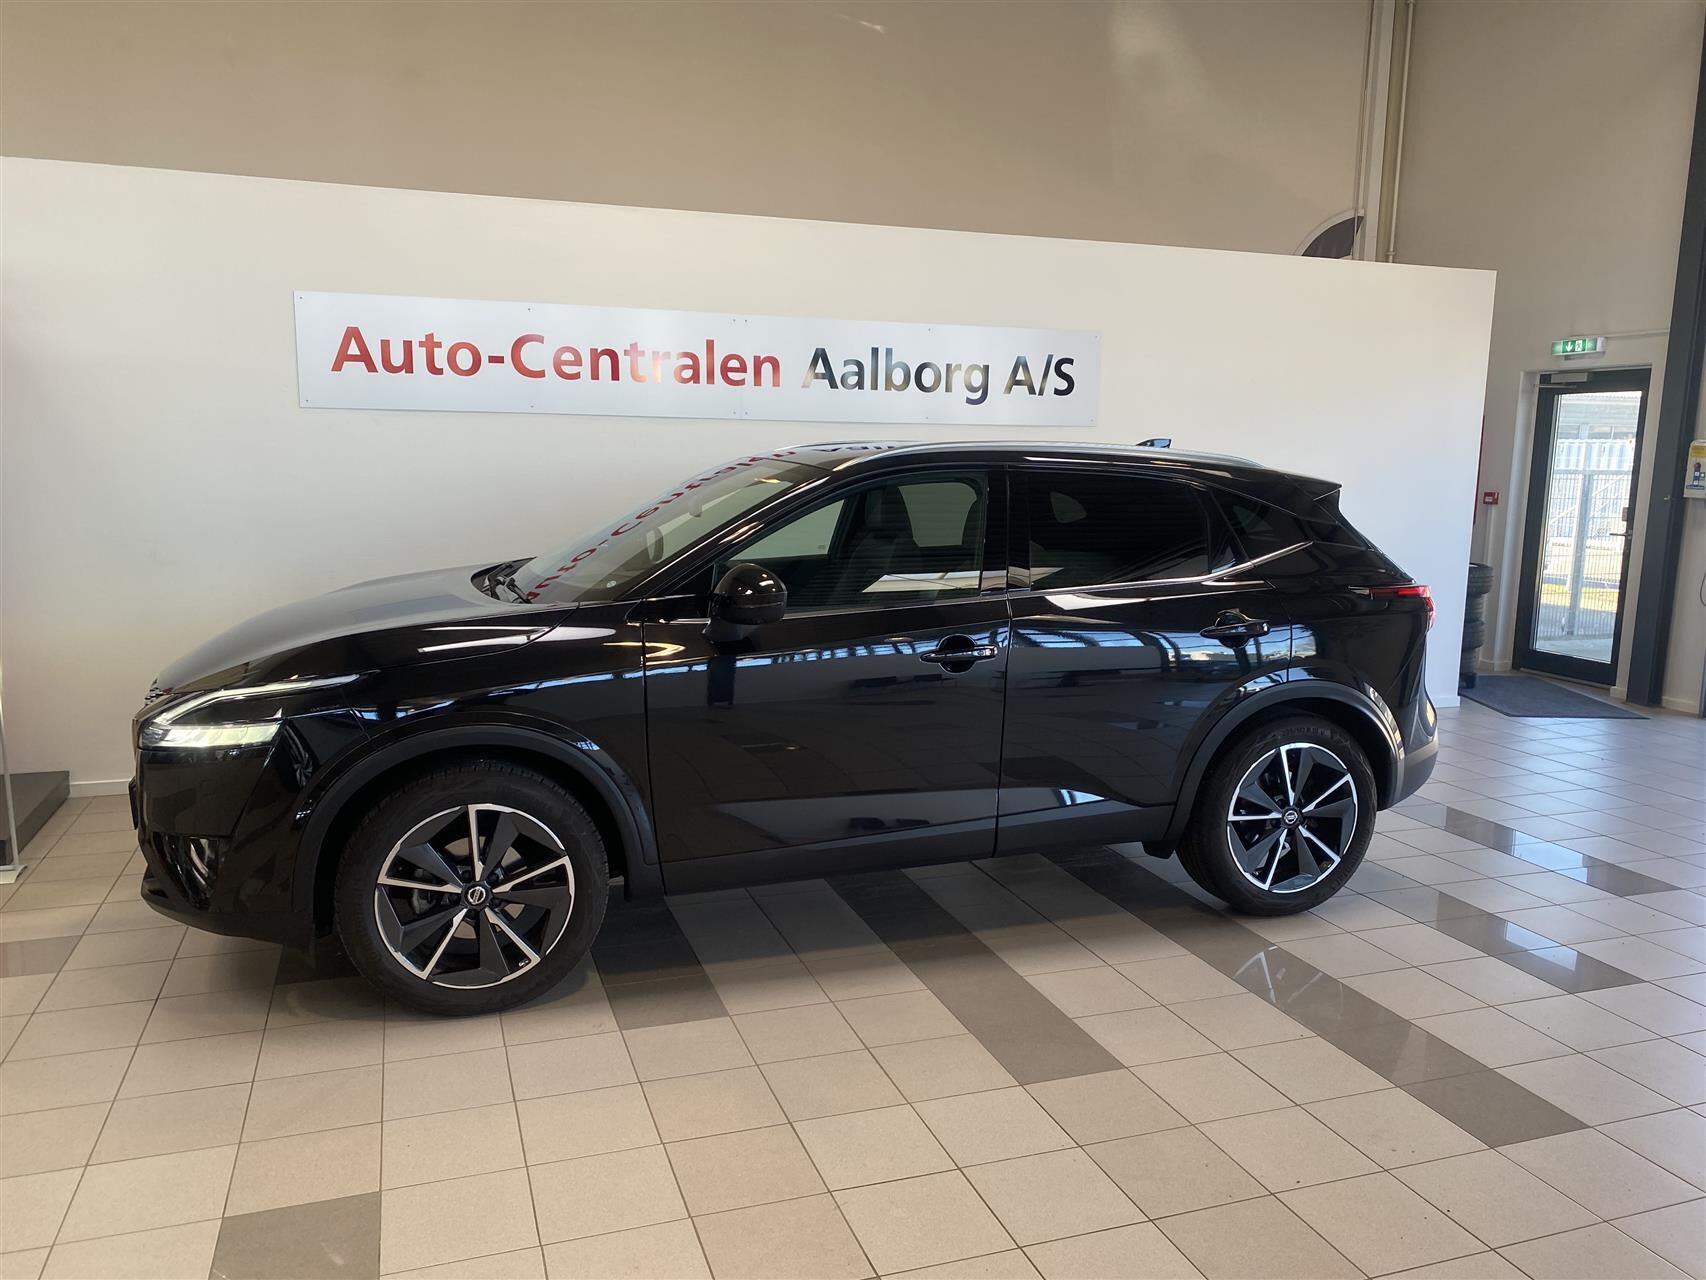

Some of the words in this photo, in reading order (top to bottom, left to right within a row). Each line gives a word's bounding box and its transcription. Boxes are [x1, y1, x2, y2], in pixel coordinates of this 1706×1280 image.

[330, 326, 781, 388] Auto-Centralen
[801, 347, 990, 406] Aalborg
[1003, 353, 1077, 397] A/S
